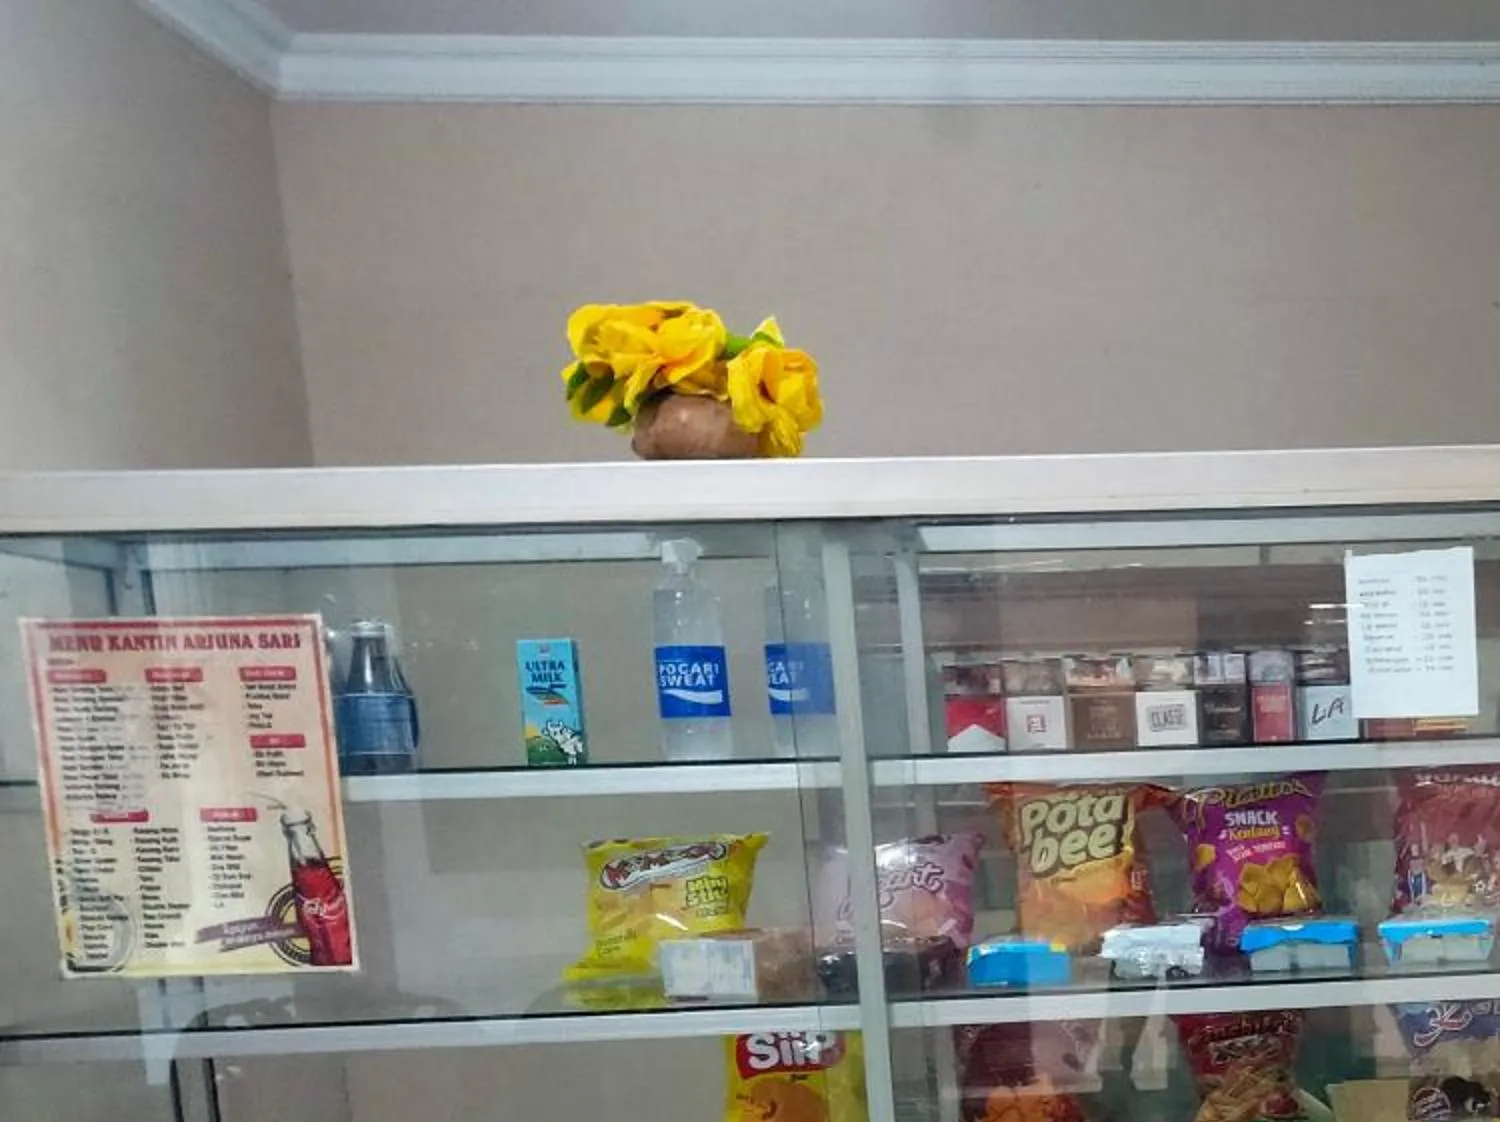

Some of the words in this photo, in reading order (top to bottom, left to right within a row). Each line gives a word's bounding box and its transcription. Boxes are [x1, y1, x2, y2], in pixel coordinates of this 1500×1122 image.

[258, 633, 302, 650] SARI
[525, 661, 566, 672] ULTRA
[532, 672, 563, 683] MILK
[659, 674, 715, 688] SWEAT
[1224, 810, 1279, 827] SNACK
[1031, 824, 1118, 874] bee
